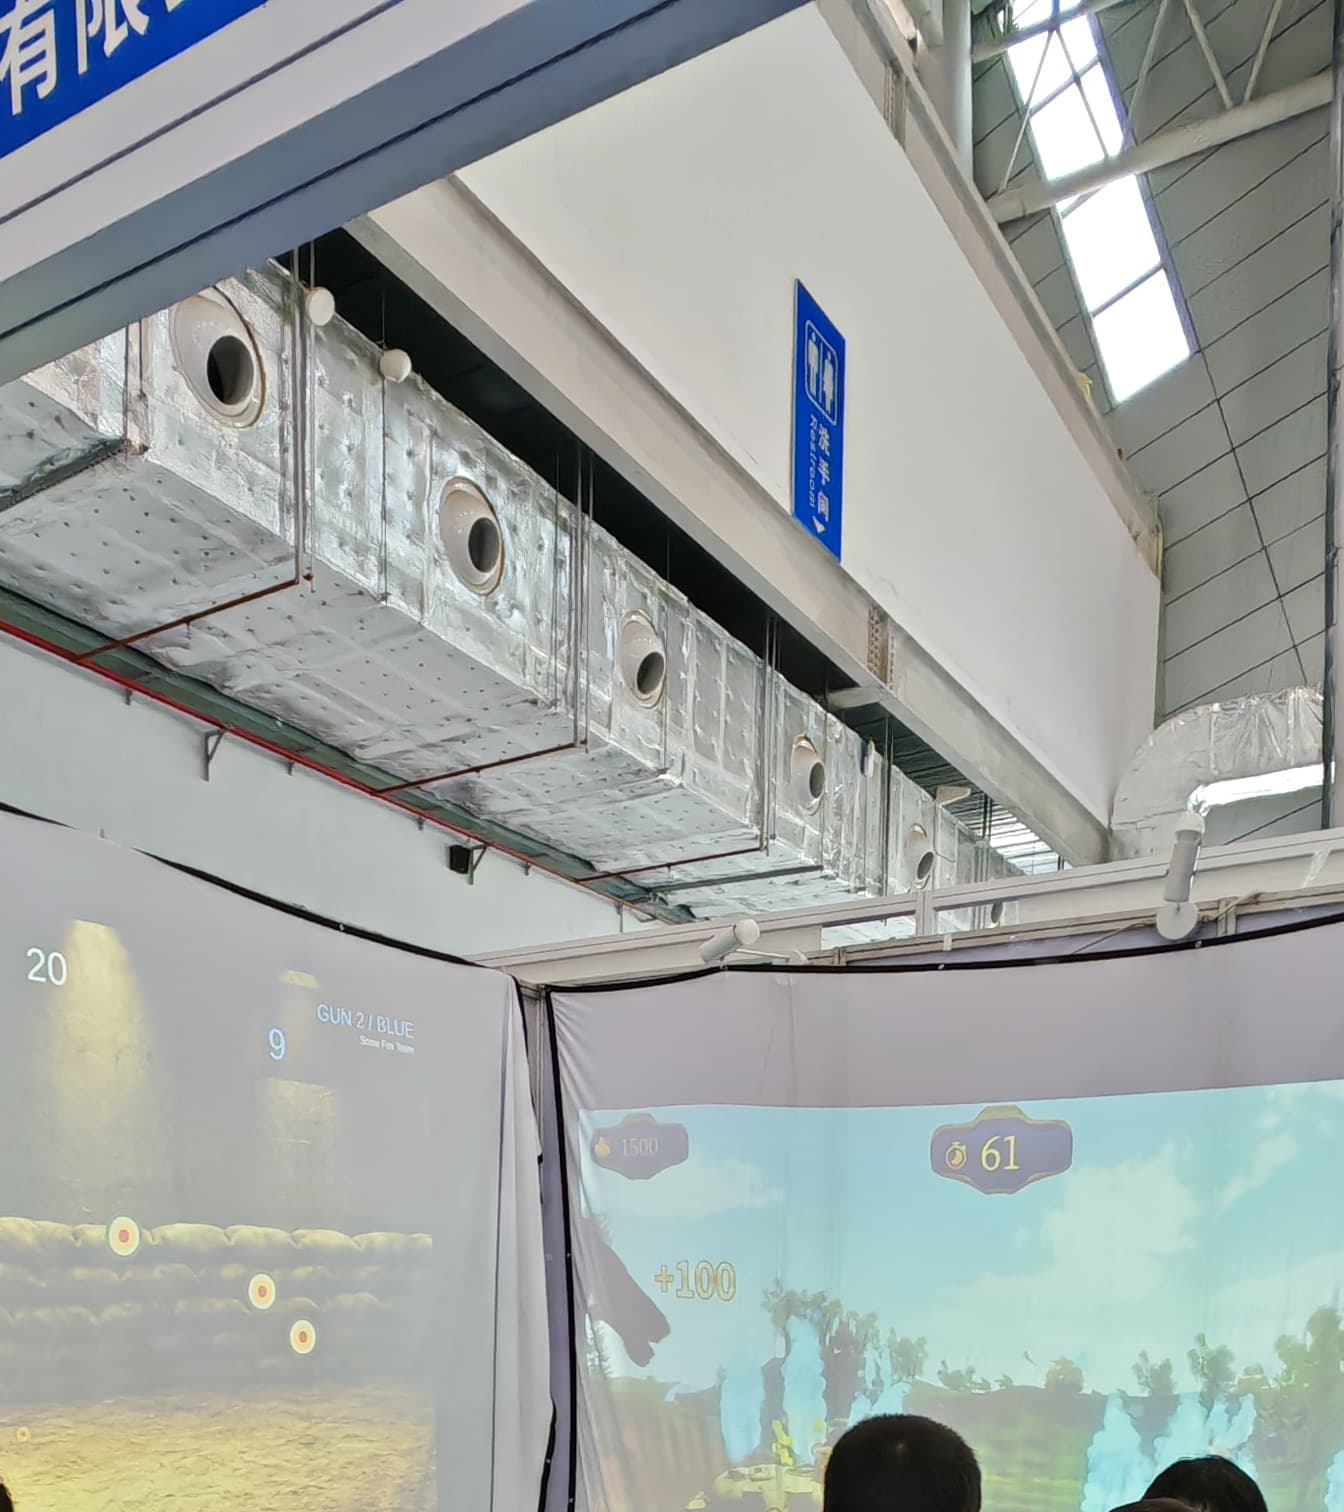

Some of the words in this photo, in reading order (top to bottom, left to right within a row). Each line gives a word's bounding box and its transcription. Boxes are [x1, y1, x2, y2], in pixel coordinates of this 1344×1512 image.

[26, 947, 68, 987] 20
[316, 1003, 353, 1027] GUN
[356, 1011, 366, 1030] 2
[377, 1015, 415, 1039] BLUE
[268, 1028, 288, 1061] 9
[622, 1137, 659, 1158] 1500
[979, 1136, 1021, 1172] 61
[654, 1260, 737, 1301] +100
